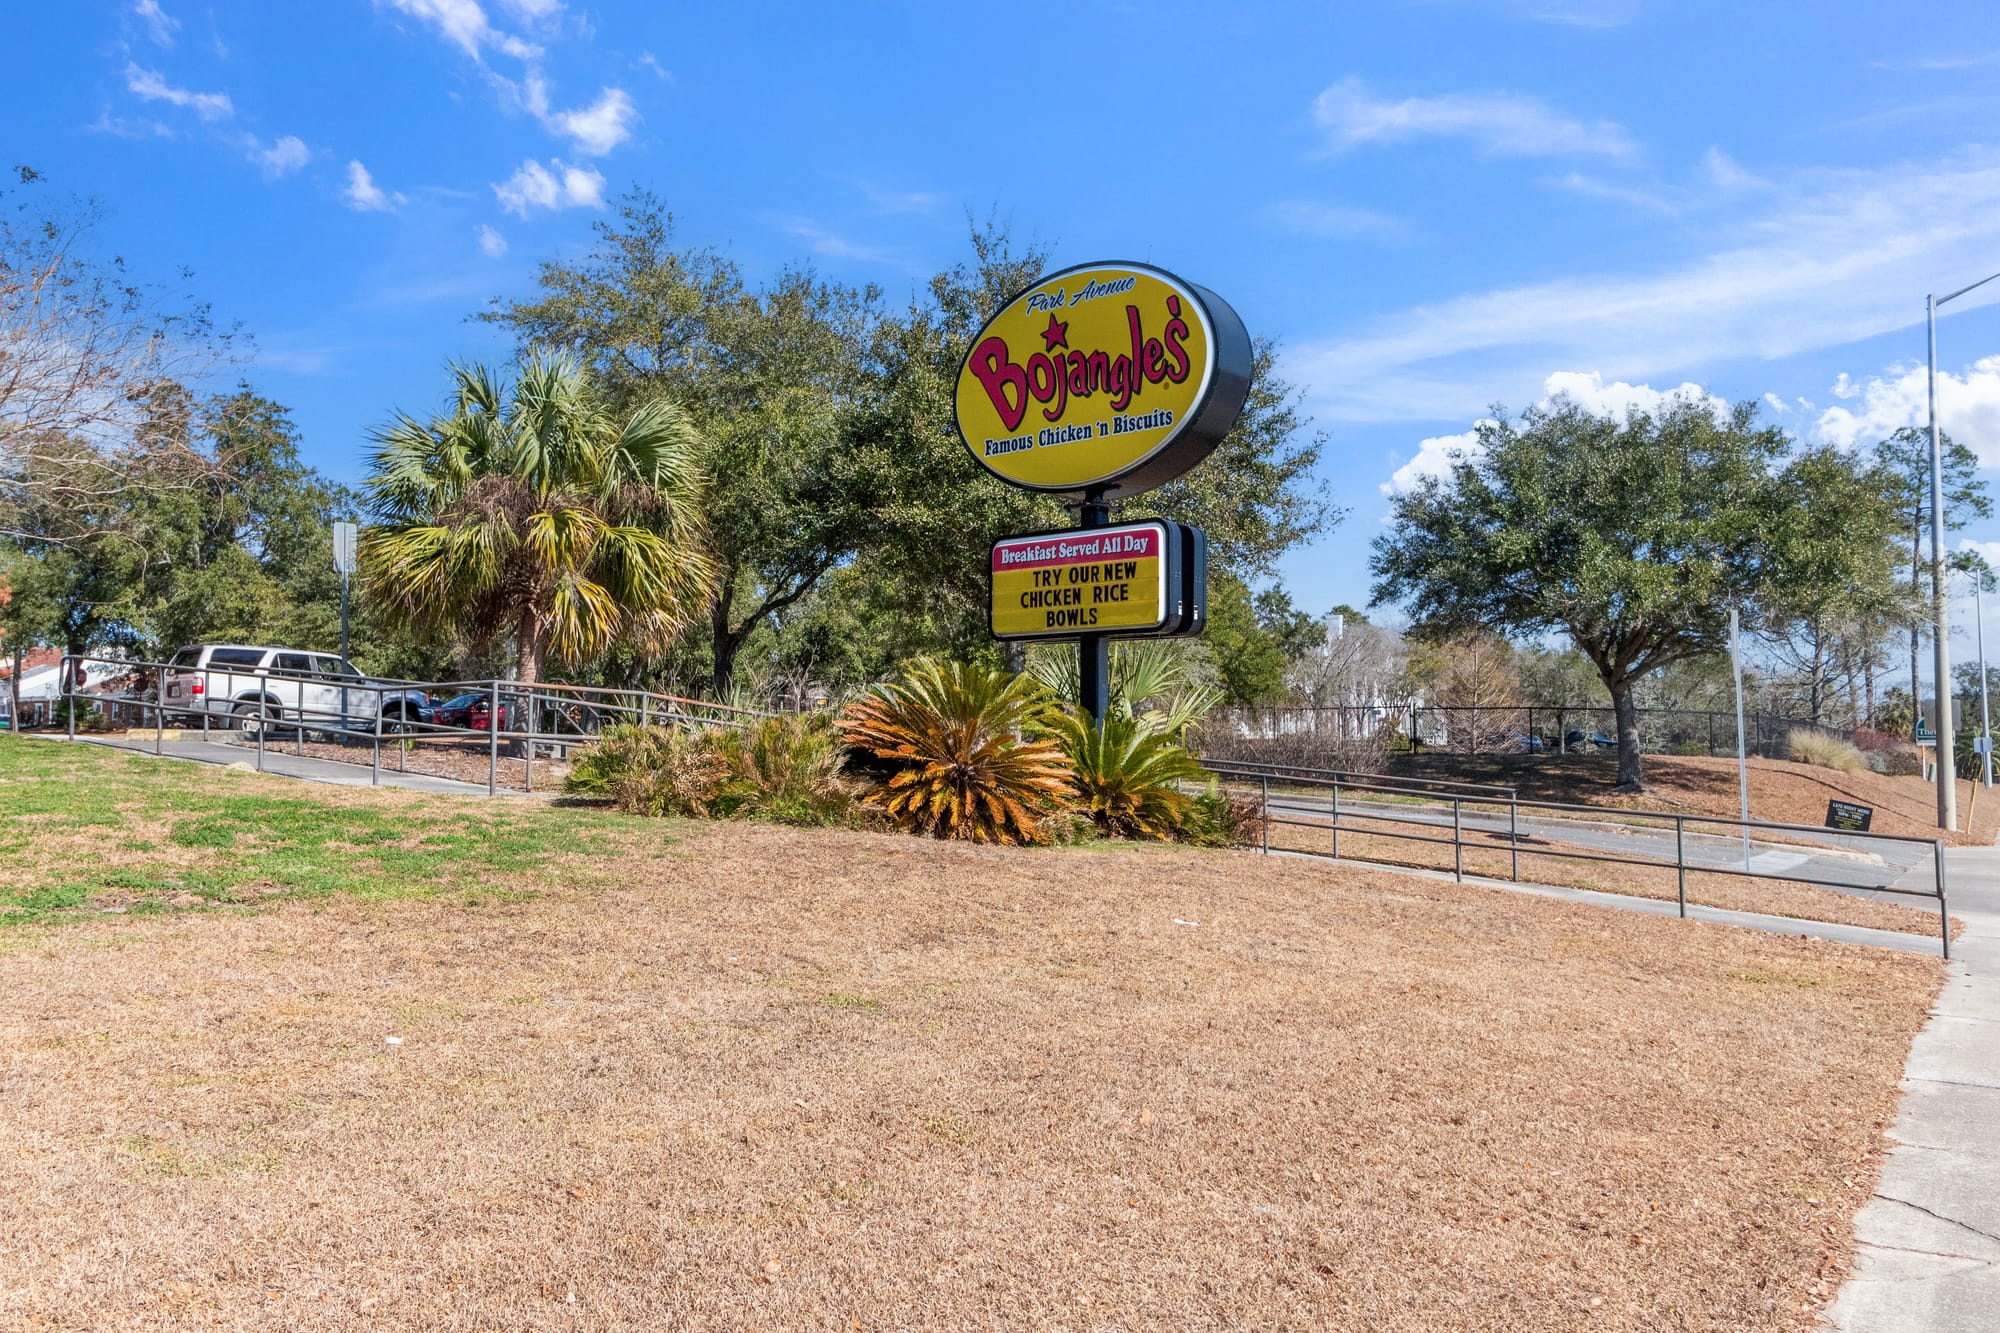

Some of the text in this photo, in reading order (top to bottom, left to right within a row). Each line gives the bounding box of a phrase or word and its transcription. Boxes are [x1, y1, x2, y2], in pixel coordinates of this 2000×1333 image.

[1026, 275, 1136, 316] Park Avenue
[984, 434, 1034, 458] Famous
[1037, 421, 1093, 447] Chicken
[1112, 408, 1174, 436] Biscuits
[1001, 535, 1149, 564] Breakfast Served All Day
[1033, 561, 1137, 588] TRY OUR NEW
[1020, 584, 1129, 608] CHICKEN RICE
[1046, 607, 1098, 628] BOWLS
